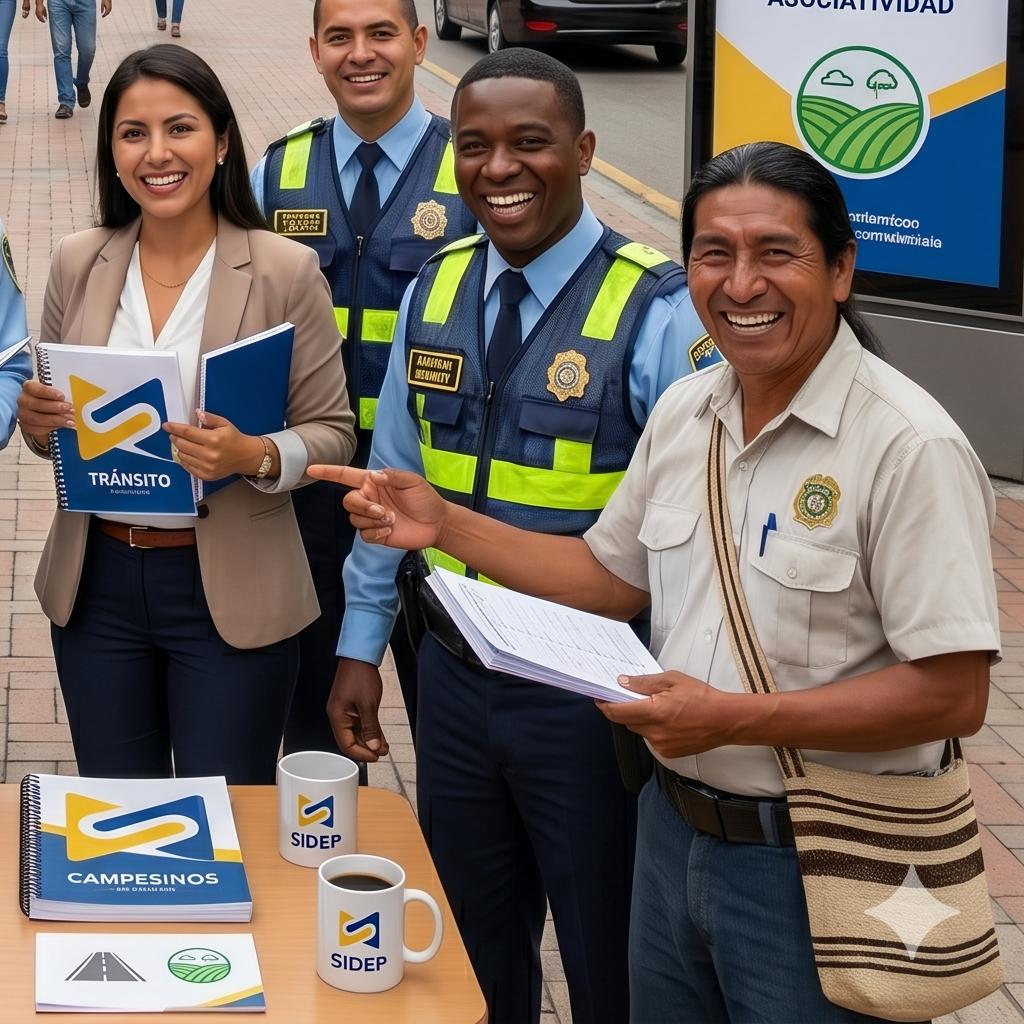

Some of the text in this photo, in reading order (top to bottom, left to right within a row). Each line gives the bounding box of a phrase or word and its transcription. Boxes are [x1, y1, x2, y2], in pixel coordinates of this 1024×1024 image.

[88, 469, 170, 487] TRÁNSITO
[291, 832, 341, 849] SIDEP
[68, 873, 218, 885] CAMPESINOS
[331, 953, 387, 971] SIDEP
